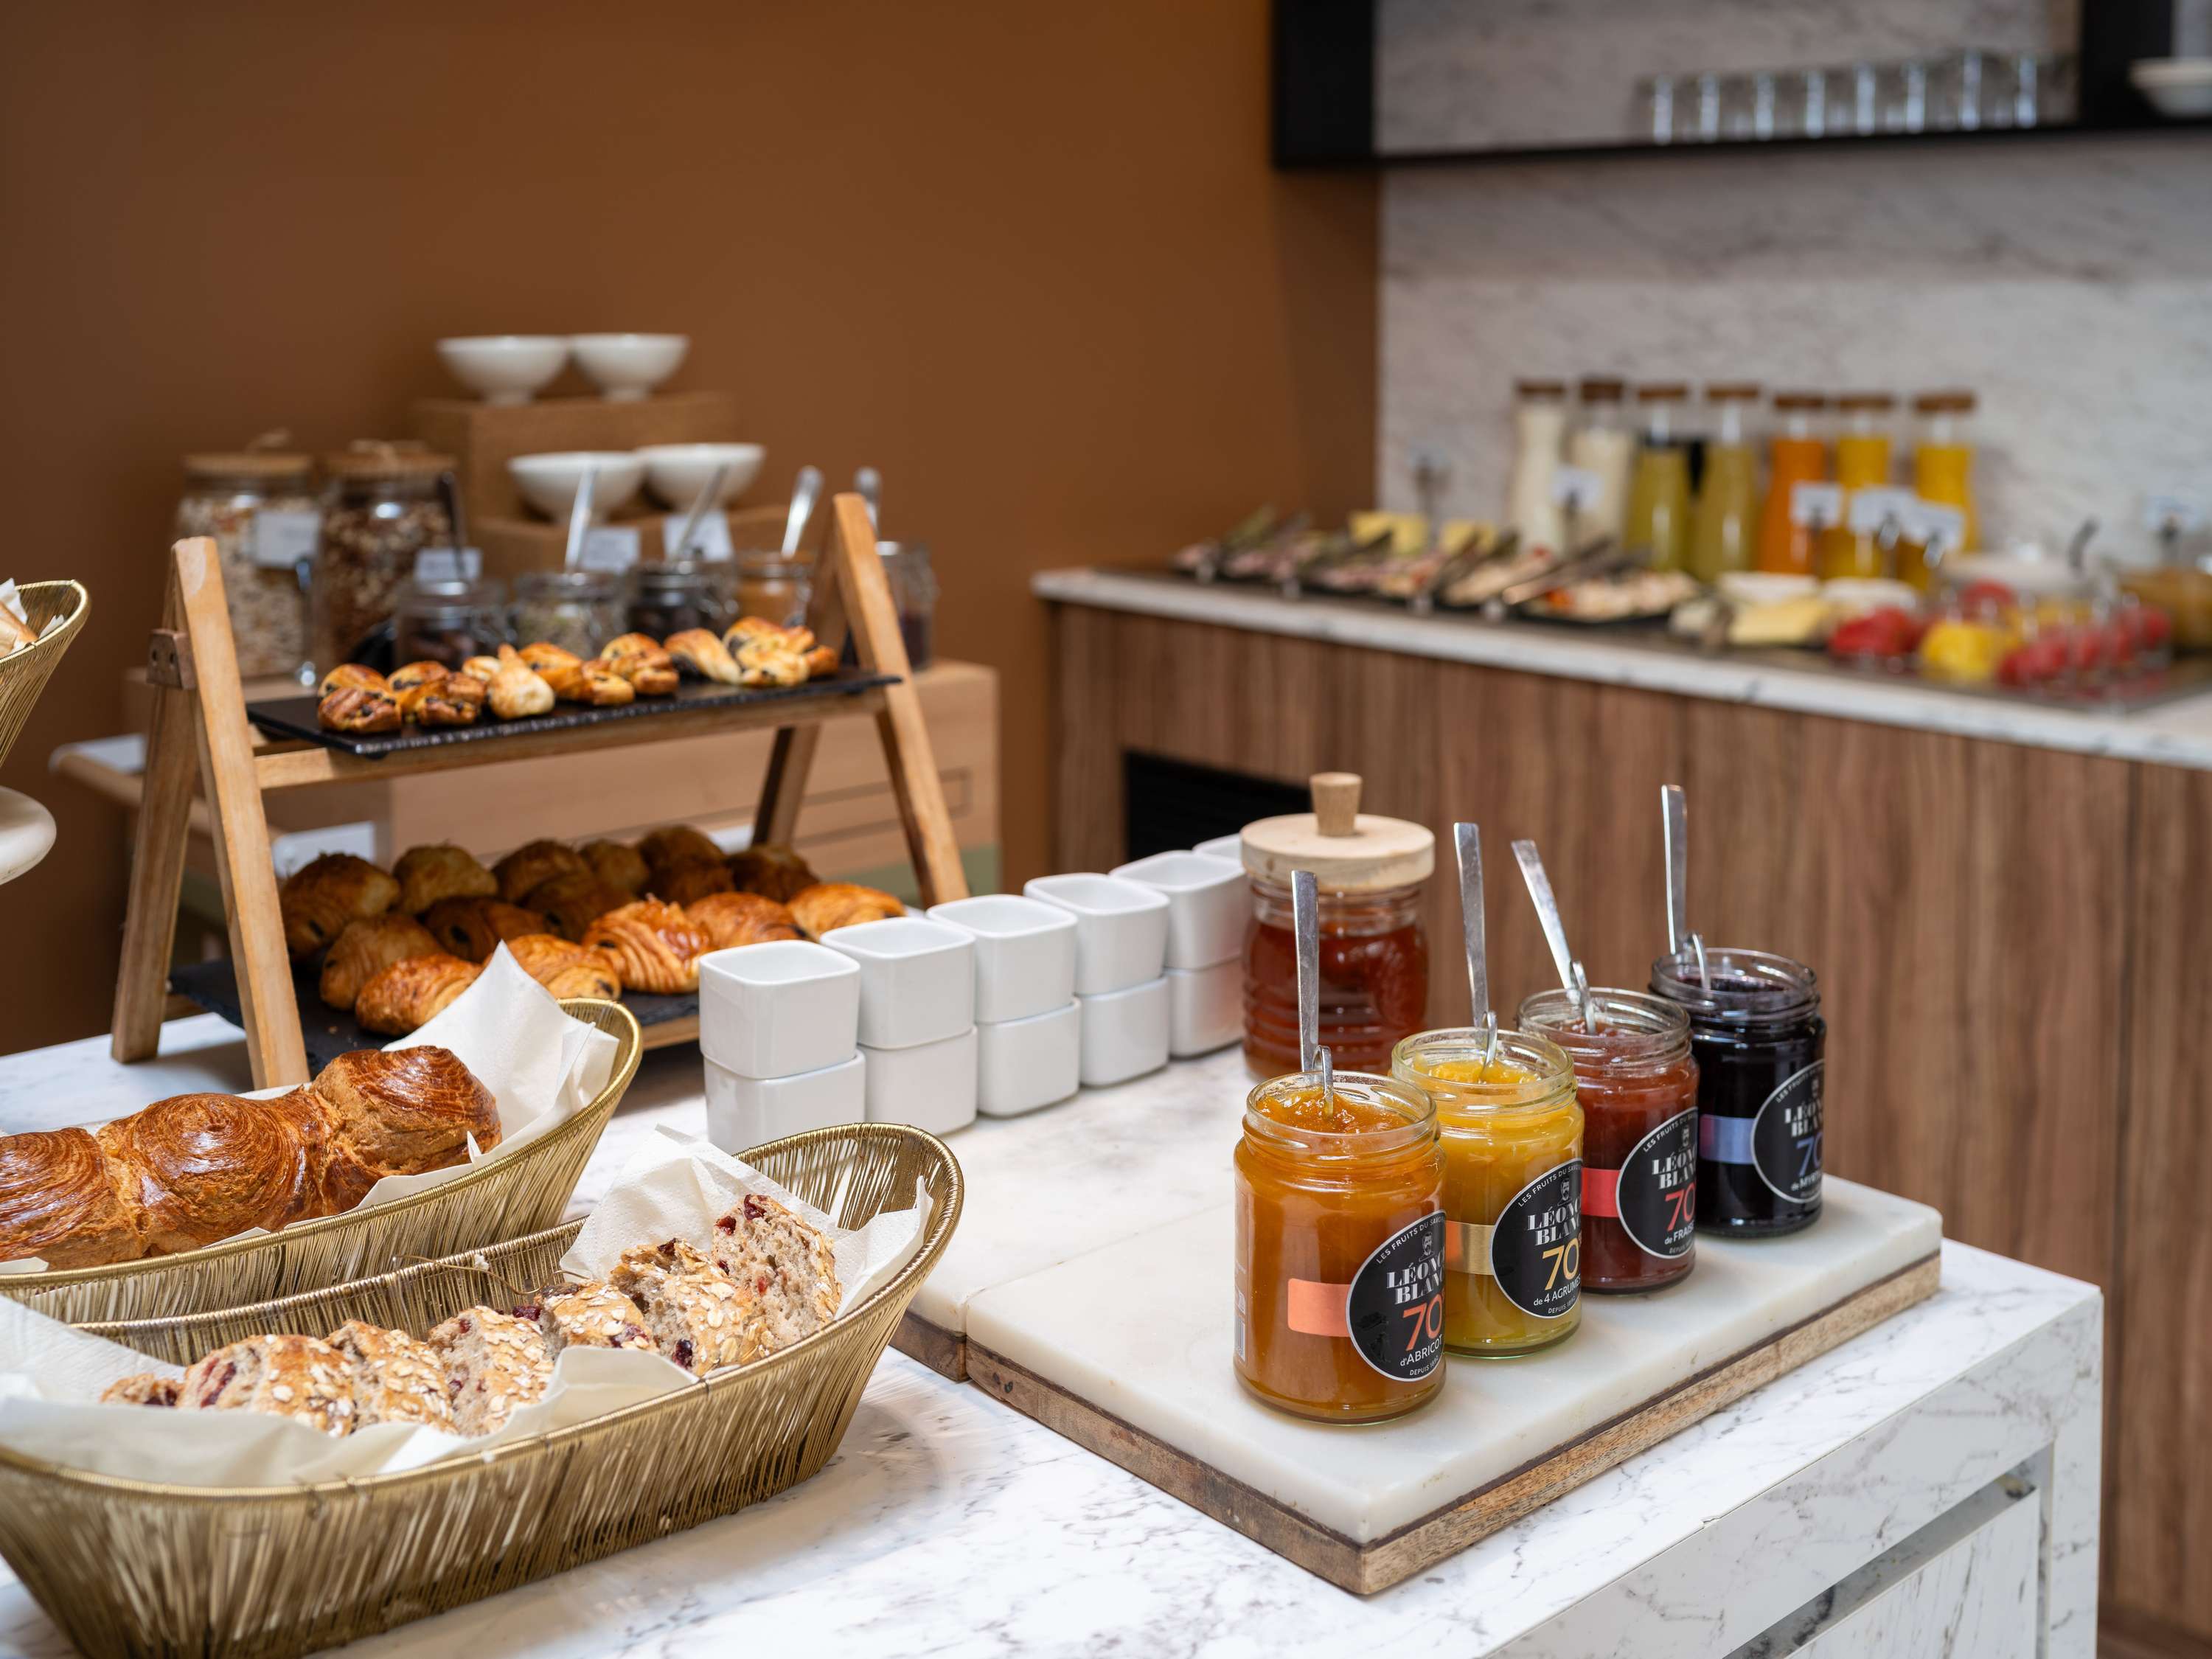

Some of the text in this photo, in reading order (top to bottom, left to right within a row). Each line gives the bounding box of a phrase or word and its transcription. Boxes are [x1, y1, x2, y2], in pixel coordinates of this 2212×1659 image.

[1643, 1138, 1656, 1152] LES
[1656, 1121, 1679, 1141] FRUITS
[1518, 1194, 1532, 1207] LES
[1532, 1173, 1557, 1195] FRUITS
[1558, 1168, 1567, 1178] DU
[1376, 1250, 1391, 1265] LES
[1391, 1228, 1418, 1251] FRUITS
[1419, 1220, 1429, 1231] DU
[1664, 1237, 1673, 1245] de
[1544, 1293, 1550, 1303] 4
[1548, 1304, 1566, 1313] DEPUIS
[1400, 1334, 1442, 1366] d'ABRICOT
[1410, 1365, 1430, 1376] DEPUIS
